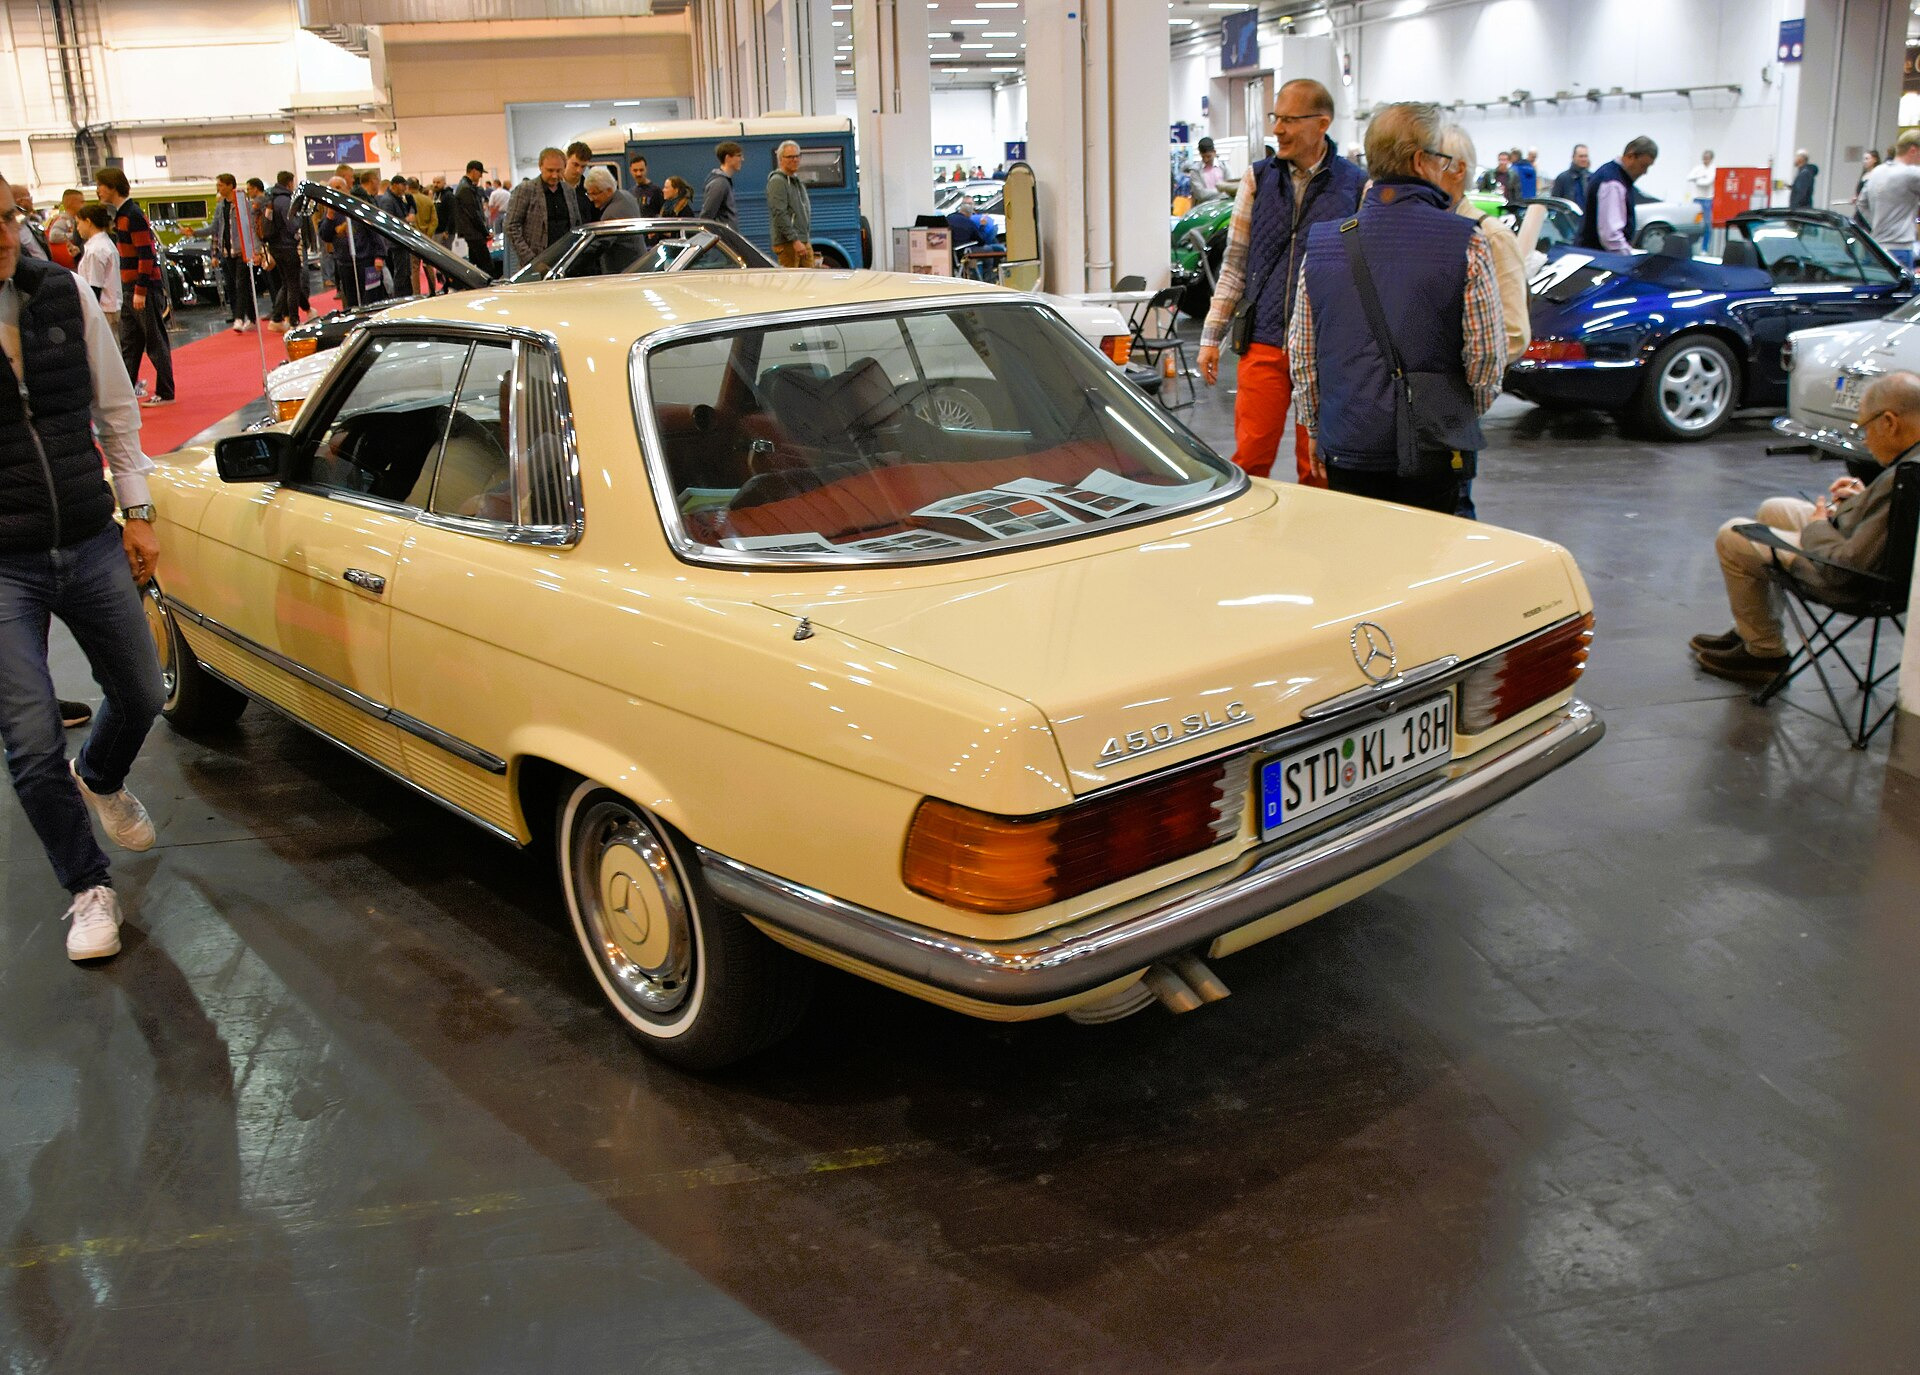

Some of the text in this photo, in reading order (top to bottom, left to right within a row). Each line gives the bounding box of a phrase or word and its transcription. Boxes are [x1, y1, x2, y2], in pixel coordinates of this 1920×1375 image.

[1010, 143, 1020, 159] 4
[1101, 701, 1247, 757] 450 SLC
[1285, 703, 1448, 811] STD KL 18H
[1268, 802, 1277, 817] D
